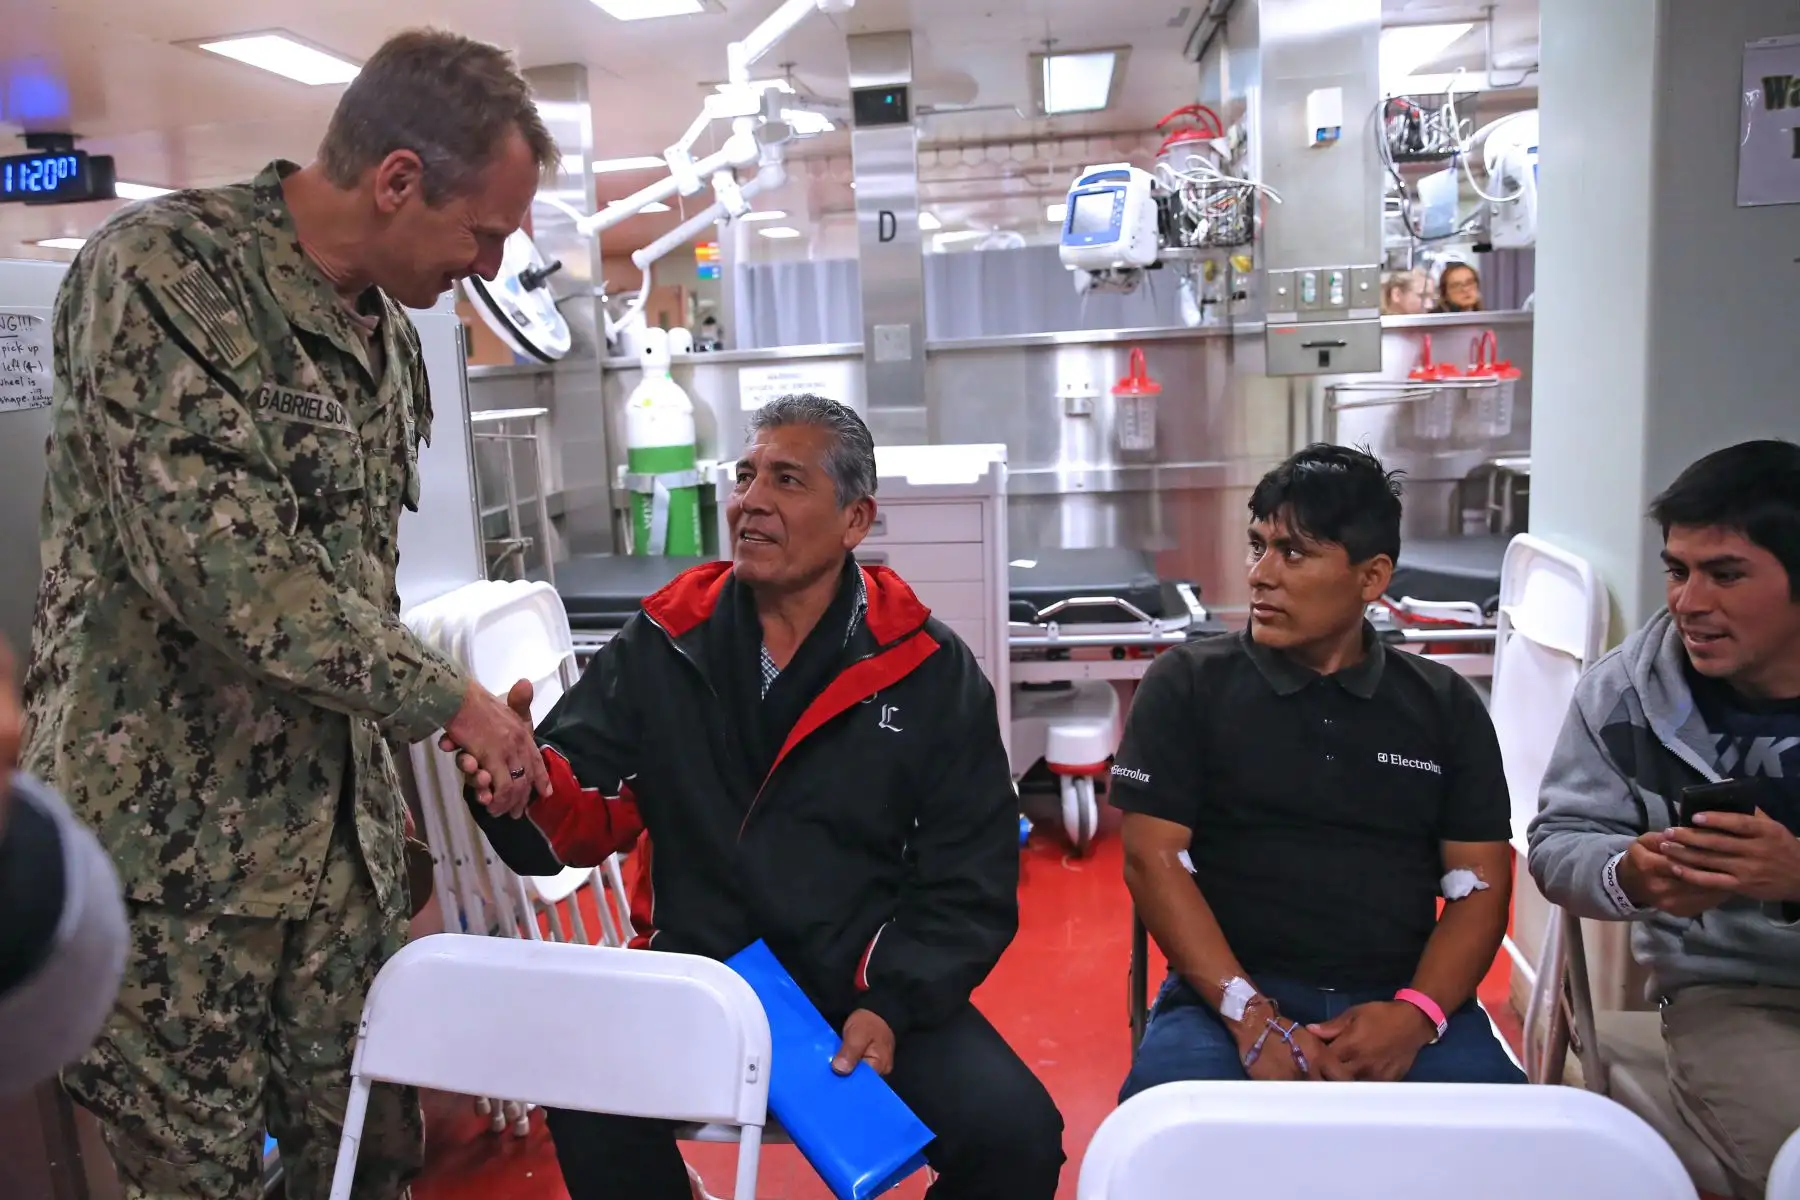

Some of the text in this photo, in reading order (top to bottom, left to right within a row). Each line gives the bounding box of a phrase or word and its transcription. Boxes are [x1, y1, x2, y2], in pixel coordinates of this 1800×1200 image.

[878, 209, 897, 243] D
[2, 341, 39, 358] pick up
[3, 359, 20, 372] left
[28, 378, 36, 387] is
